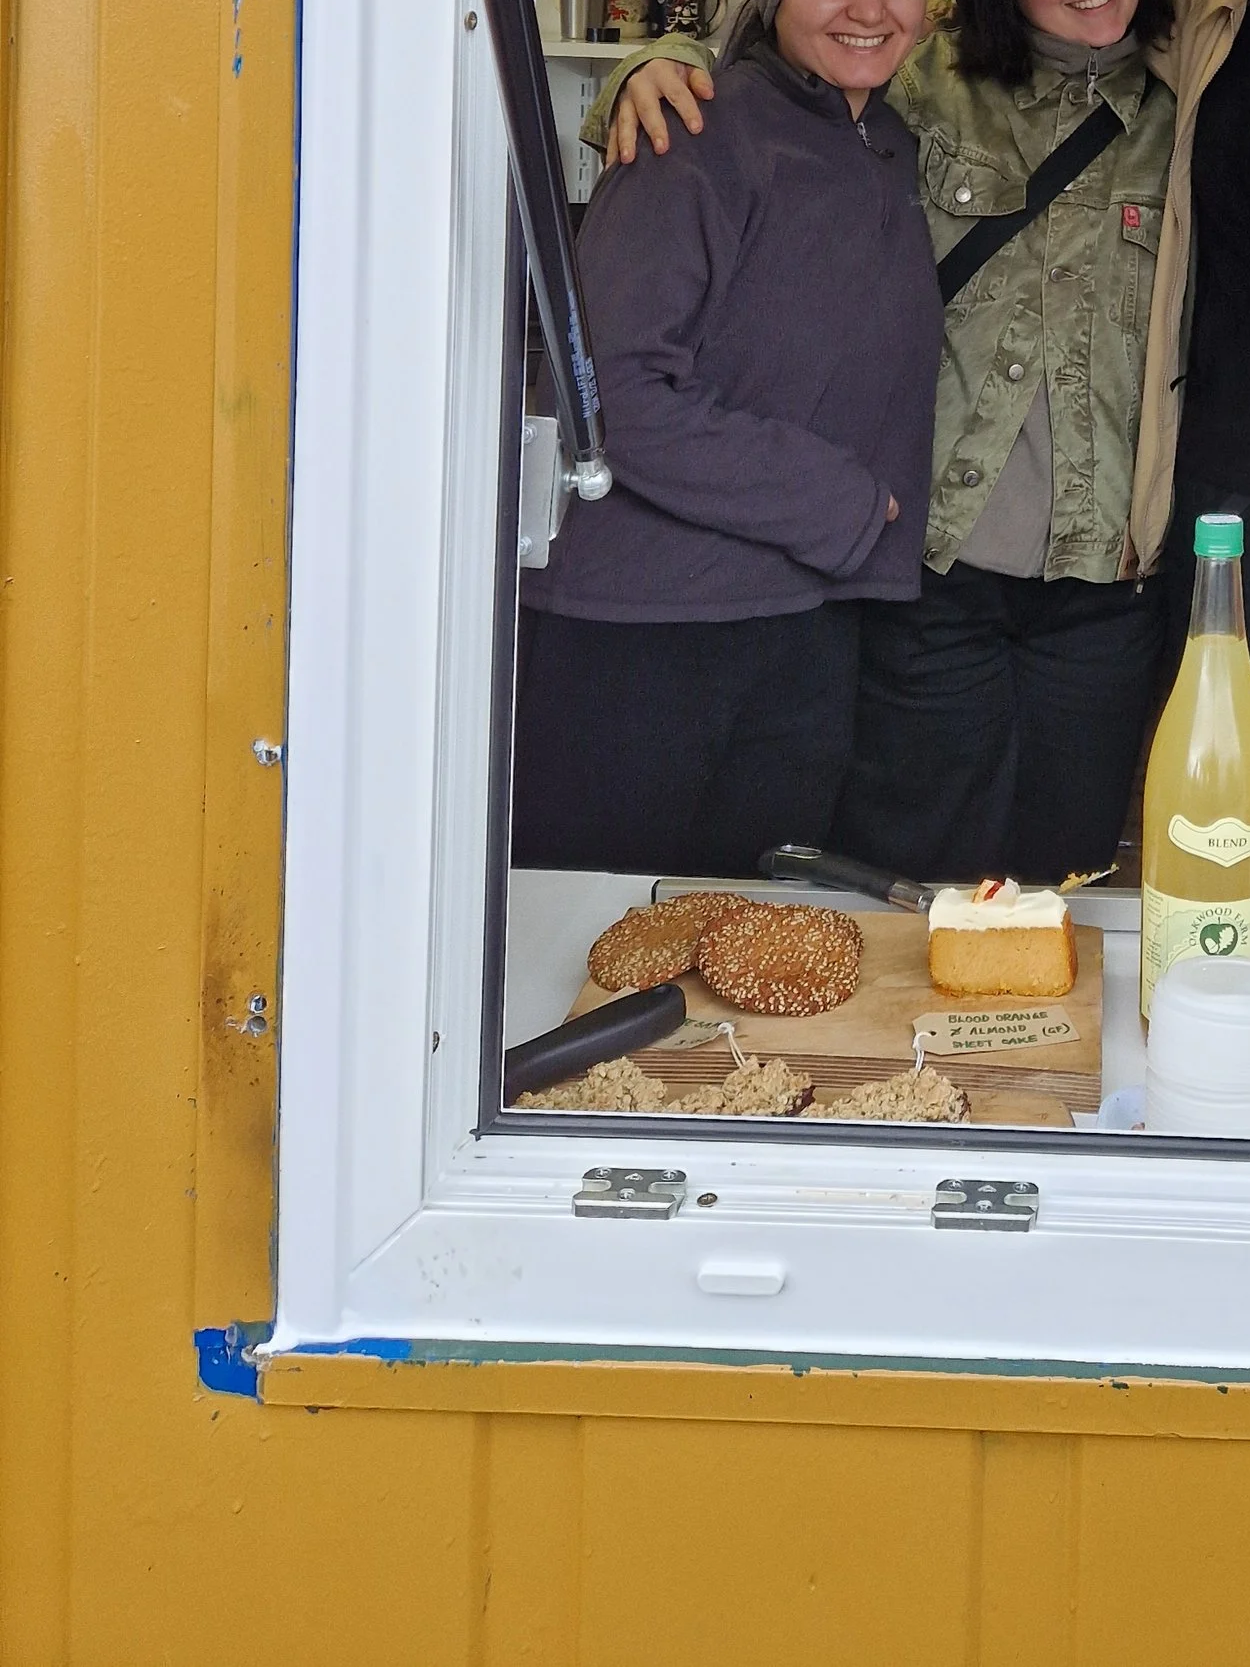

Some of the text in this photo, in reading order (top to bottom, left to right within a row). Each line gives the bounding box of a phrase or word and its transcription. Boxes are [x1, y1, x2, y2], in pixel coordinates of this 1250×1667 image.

[1208, 838, 1248, 848] BLEND
[1189, 907, 1232, 946] OAKWOOD
[1234, 913, 1248, 946] FARM
[948, 1012, 1048, 1024] BLOOD ORANGE
[970, 1024, 1027, 1036] ALMOND
[1042, 1022, 1071, 1038] (GF)
[1002, 1034, 1038, 1045] CAKE
